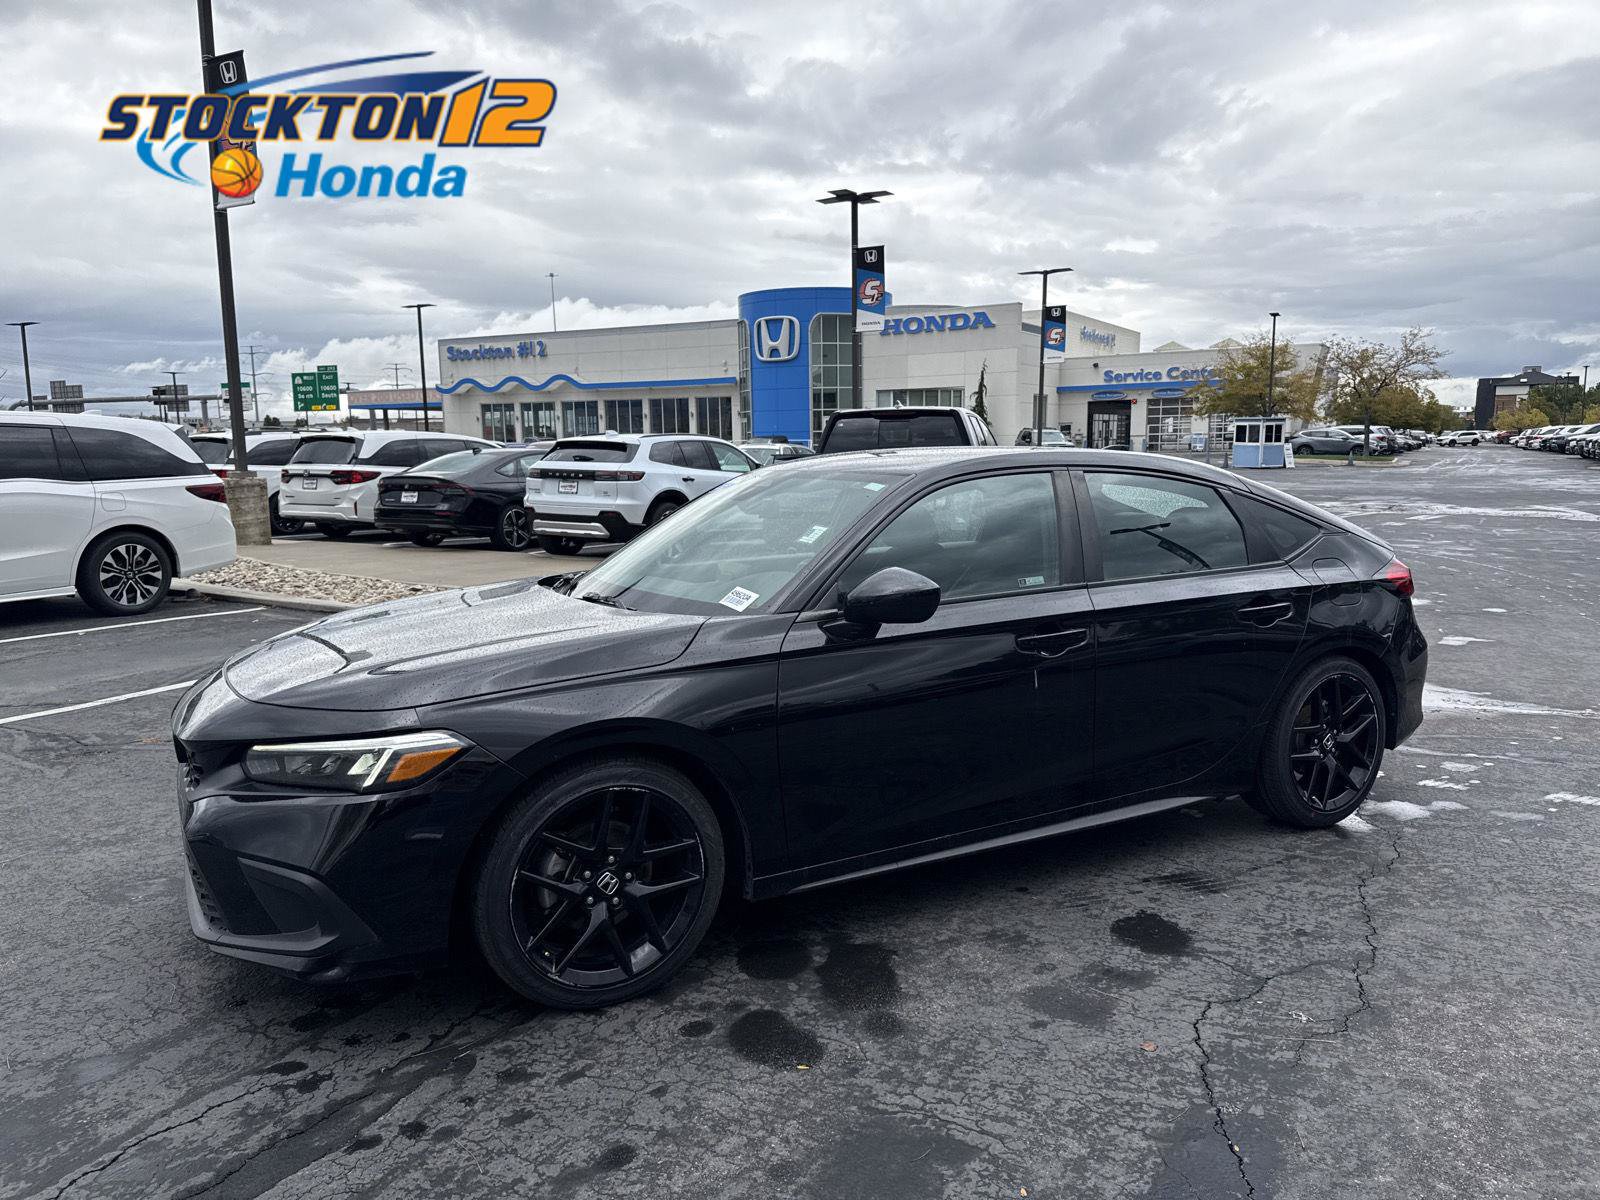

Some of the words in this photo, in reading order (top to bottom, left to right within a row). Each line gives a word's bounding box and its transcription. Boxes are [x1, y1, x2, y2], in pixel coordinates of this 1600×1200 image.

[880, 311, 996, 336] HONDA
[446, 345, 513, 361] Stockton
[516, 339, 547, 358] #12
[1103, 368, 1162, 382] Service
